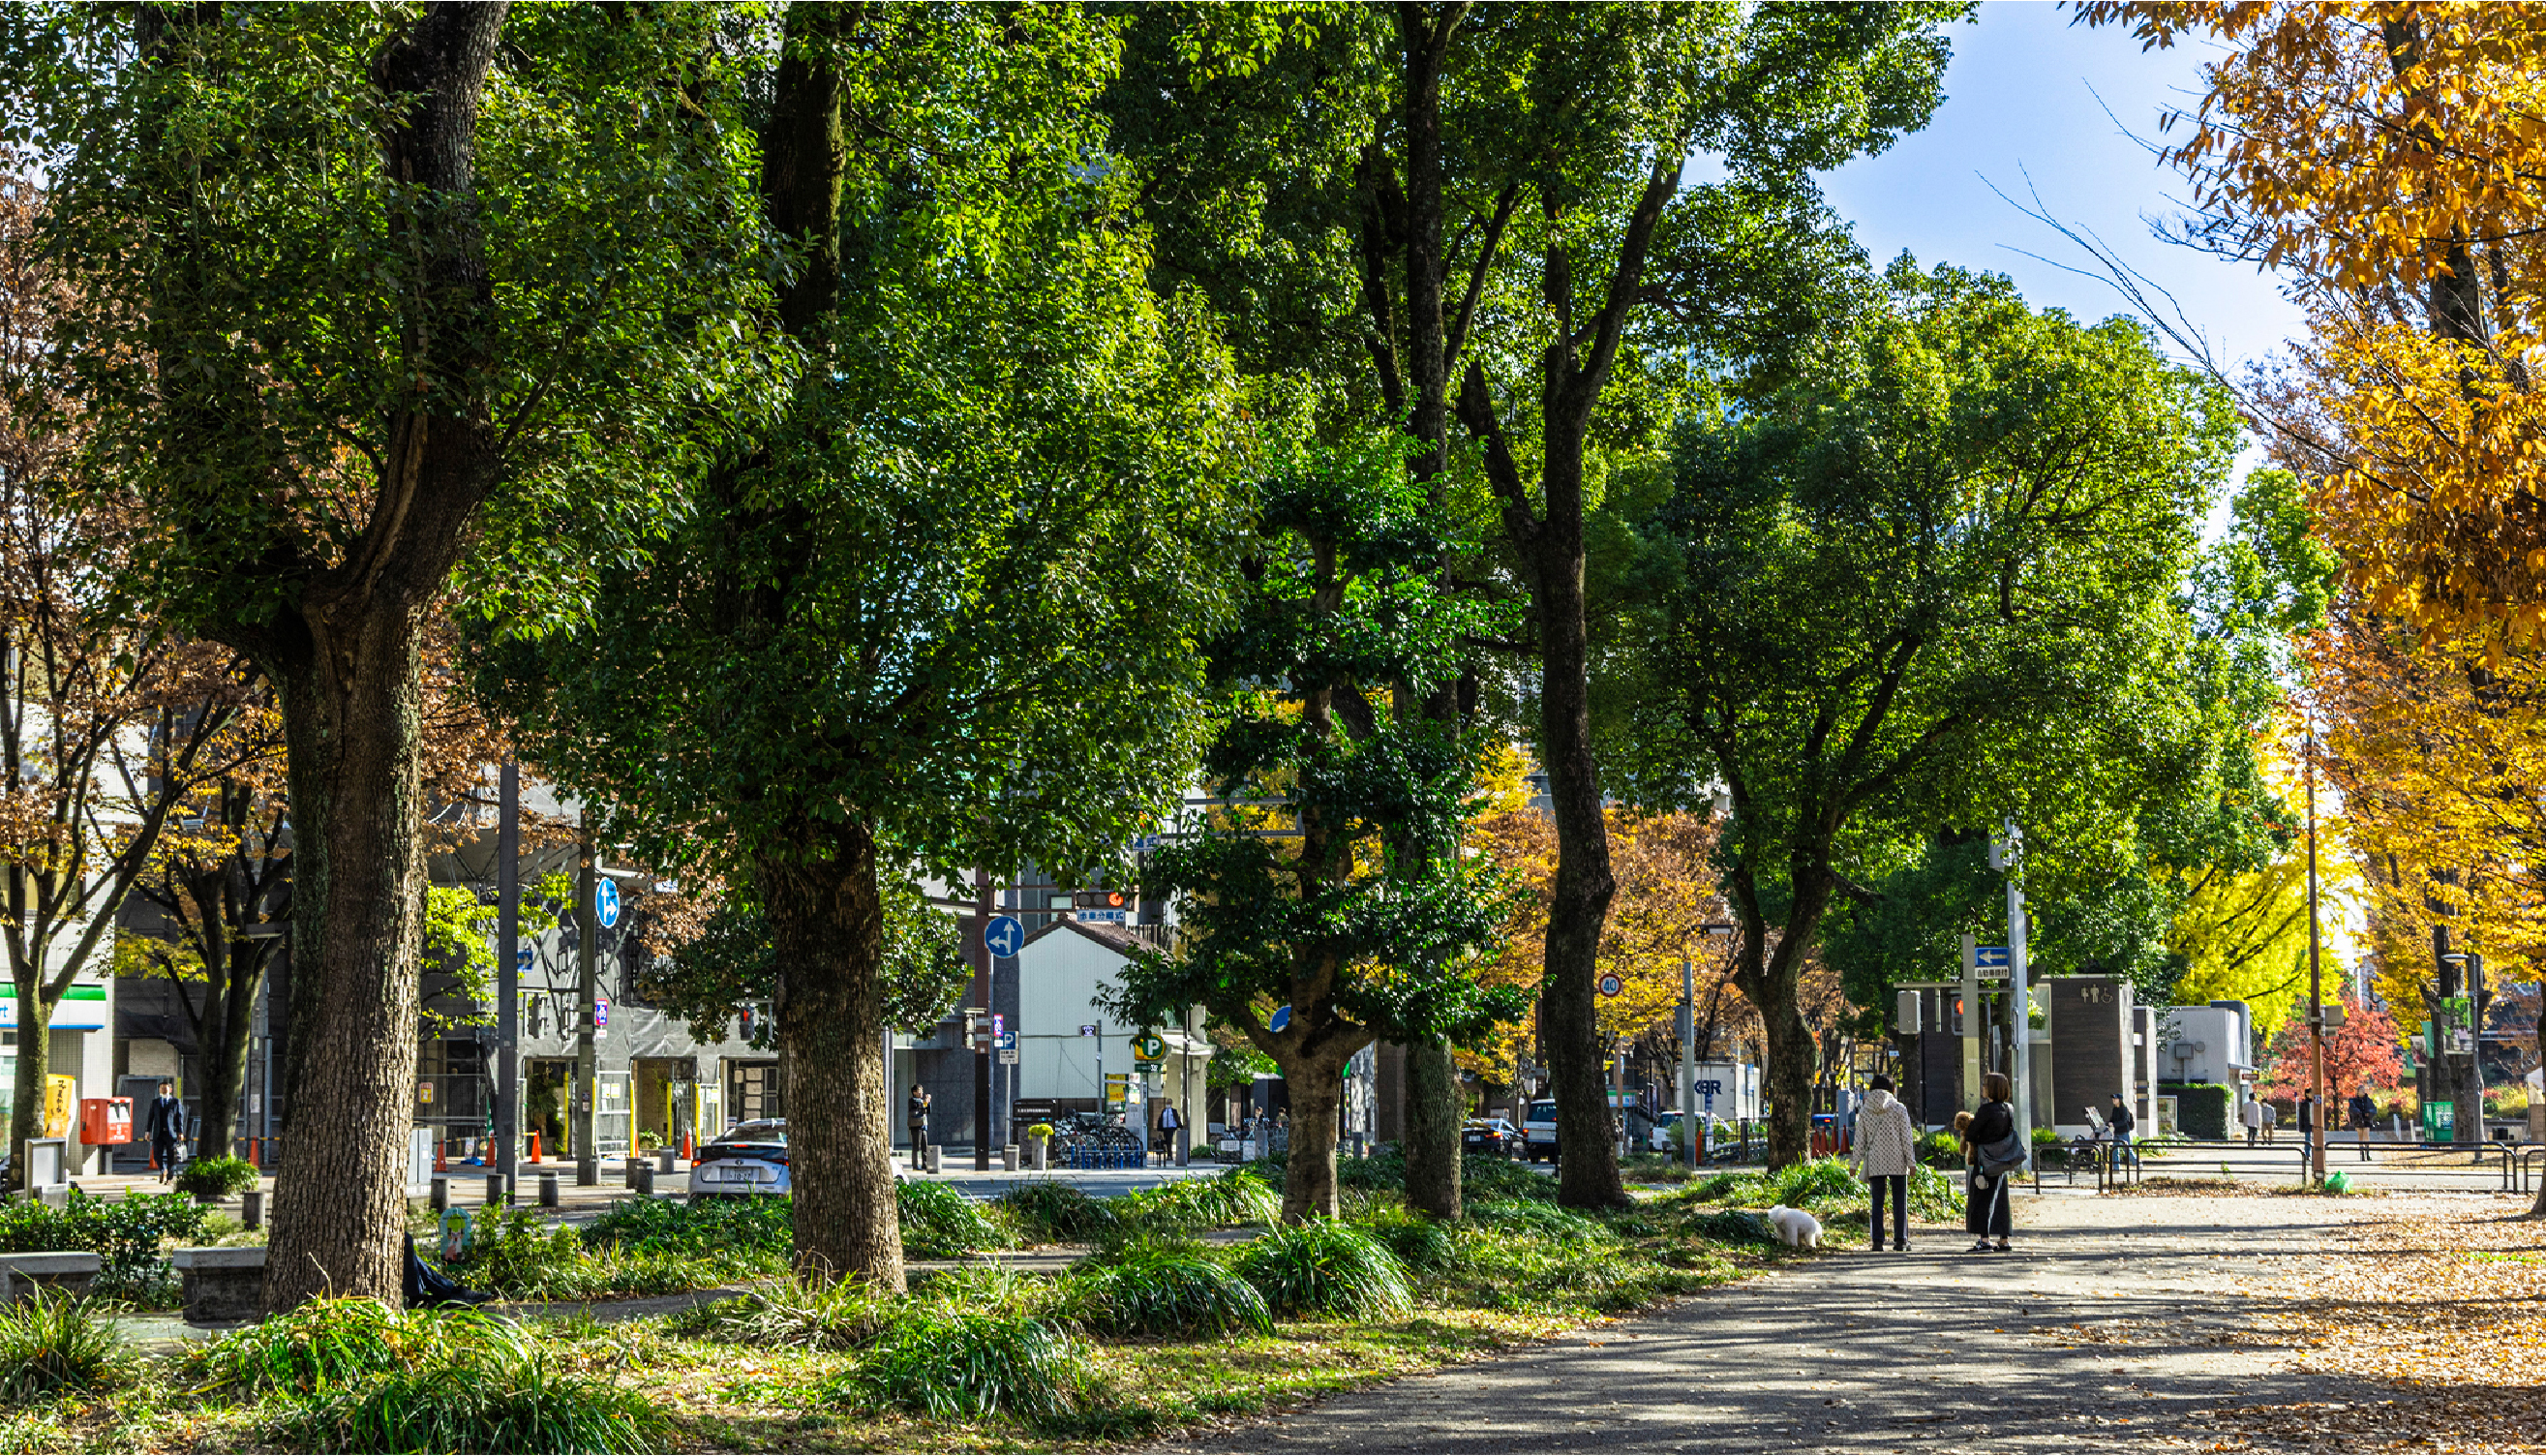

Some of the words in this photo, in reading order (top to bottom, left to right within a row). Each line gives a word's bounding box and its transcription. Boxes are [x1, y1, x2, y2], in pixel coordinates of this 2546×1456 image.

[1603, 979, 1617, 991] 40
[1004, 1034, 1015, 1048] P
[1147, 1039, 1160, 1055] P
